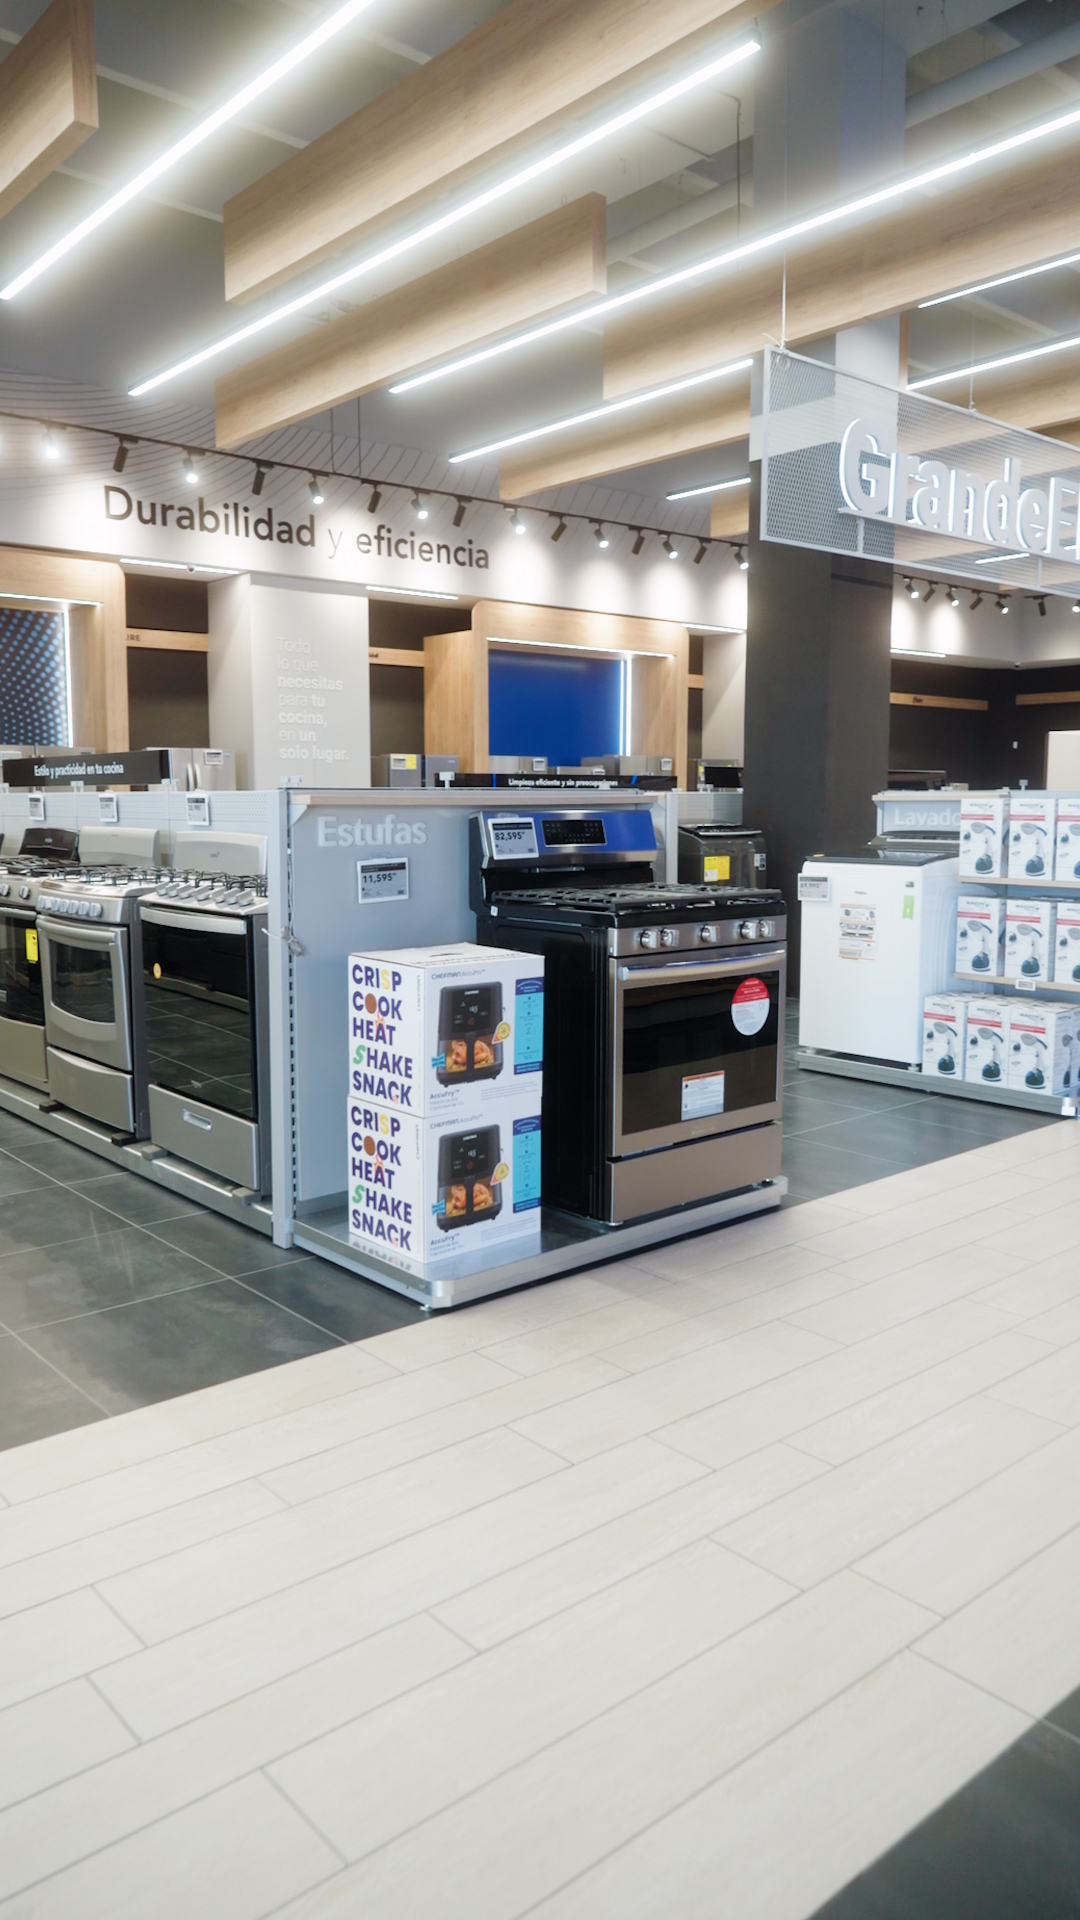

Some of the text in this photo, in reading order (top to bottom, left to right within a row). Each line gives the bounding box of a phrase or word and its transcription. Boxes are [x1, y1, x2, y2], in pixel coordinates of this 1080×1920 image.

[838, 418, 1080, 563] GrandeE
[104, 485, 490, 569] Durabilidad y eficiencia
[277, 637, 311, 654] Todo
[277, 655, 318, 673] lo que
[278, 675, 344, 691] necesitas
[279, 693, 325, 708] para tu
[279, 710, 328, 728] cocina,
[280, 730, 316, 742] en un
[280, 744, 350, 763] solo lugar.
[34, 761, 124, 779] Estilo y practicidad en tu cocina
[508, 778, 534, 788] Limpieza
[536, 778, 560, 786] eficiente
[561, 780, 565, 788] y
[317, 814, 428, 847] Estufas
[894, 807, 960, 826] Lavado
[352, 963, 402, 991] CRISP
[352, 990, 403, 1021] COOK
[353, 1016, 396, 1046] HEAT
[352, 1044, 413, 1079] SHAKE
[352, 1070, 412, 1107] SNACK
[351, 1106, 401, 1137] CRISP
[351, 1132, 402, 1167] COOK
[351, 1156, 395, 1190] HEAT
[352, 1184, 412, 1225] SHAKE
[352, 1209, 411, 1252] SNACK
